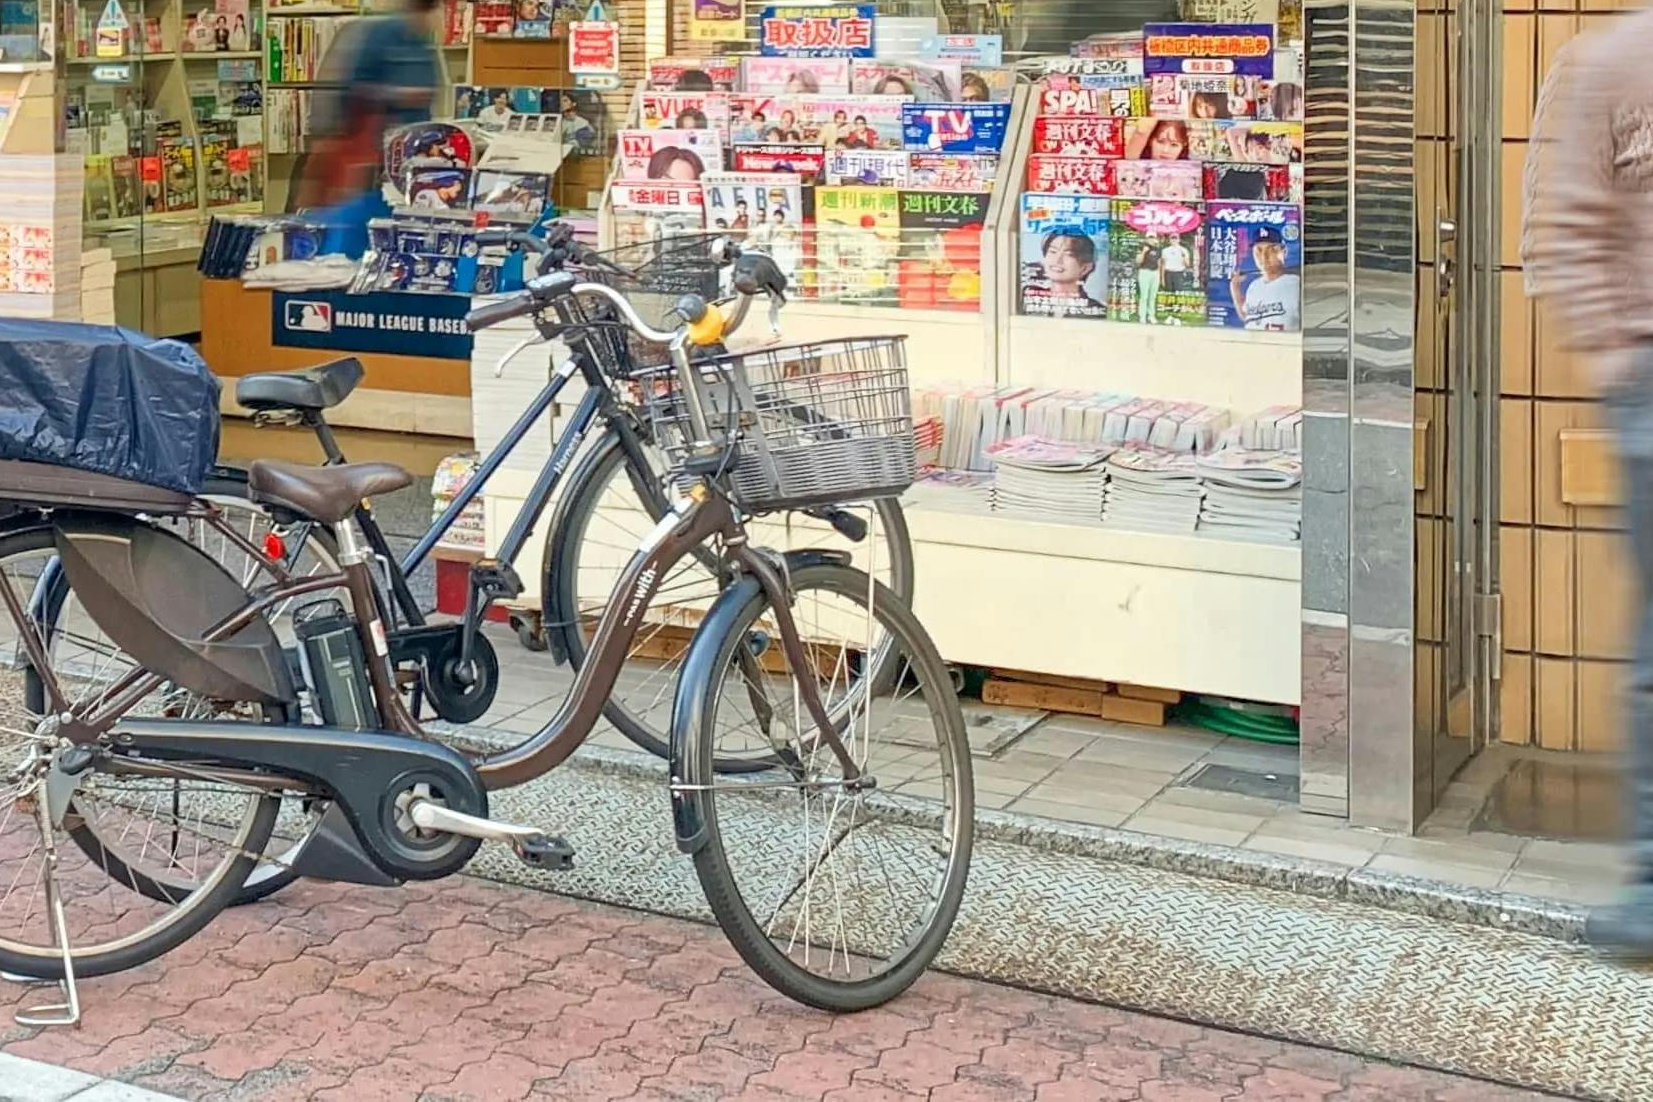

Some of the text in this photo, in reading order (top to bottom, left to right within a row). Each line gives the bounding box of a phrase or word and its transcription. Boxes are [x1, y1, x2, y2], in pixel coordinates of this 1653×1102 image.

[765, 18, 872, 49] 取扱店
[1044, 89, 1098, 115] SPA!
[924, 110, 972, 134] TV
[1047, 122, 1113, 141] 週刊文春
[624, 135, 653, 158] TV
[827, 156, 906, 177] 週刊現代
[635, 189, 681, 205] 金曜日
[711, 186, 791, 212] AERA
[821, 191, 897, 211] 週刊新潮
[904, 194, 980, 216] 週刊文春
[335, 311, 473, 336] MAJOR LEAGUE BASEB
[636, 568, 658, 599] with
